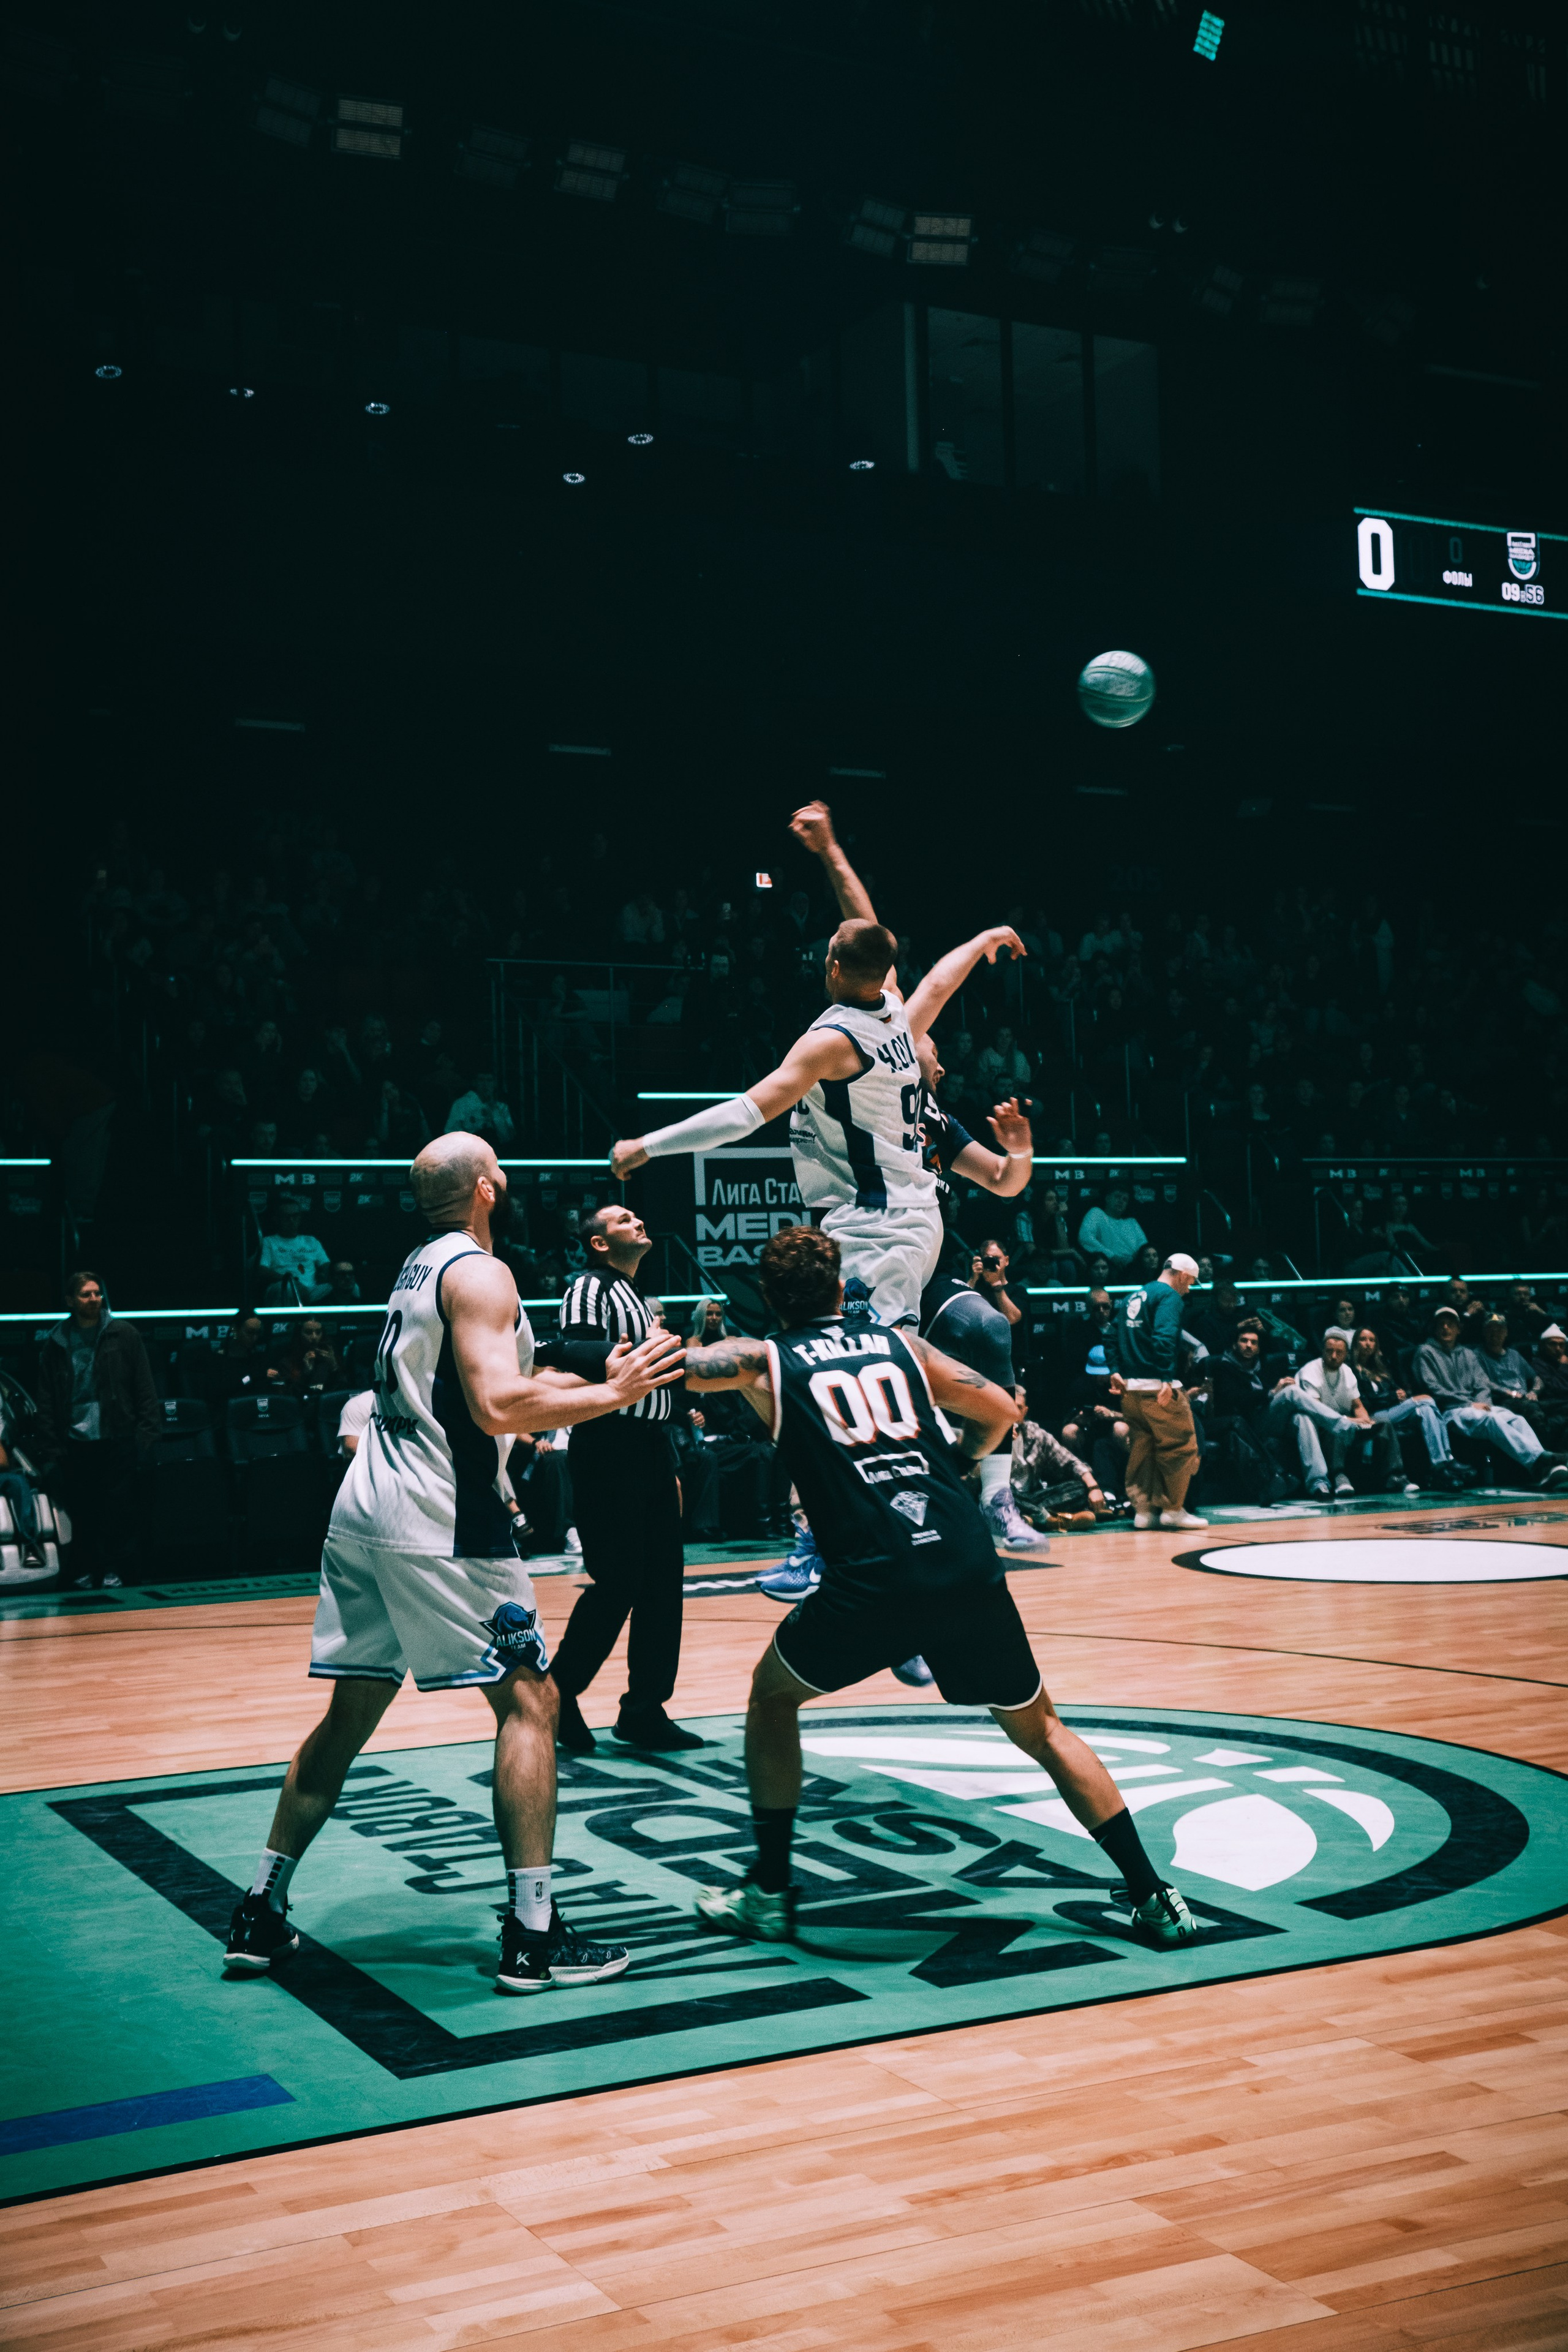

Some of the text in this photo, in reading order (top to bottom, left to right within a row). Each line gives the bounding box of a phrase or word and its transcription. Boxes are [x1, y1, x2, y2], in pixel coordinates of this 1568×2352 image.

[1357, 517, 1395, 591] 0
[764, 1178, 804, 1204] СТА
[809, 1361, 921, 1447] 00
[496, 1628, 537, 1648] ALIKSON
